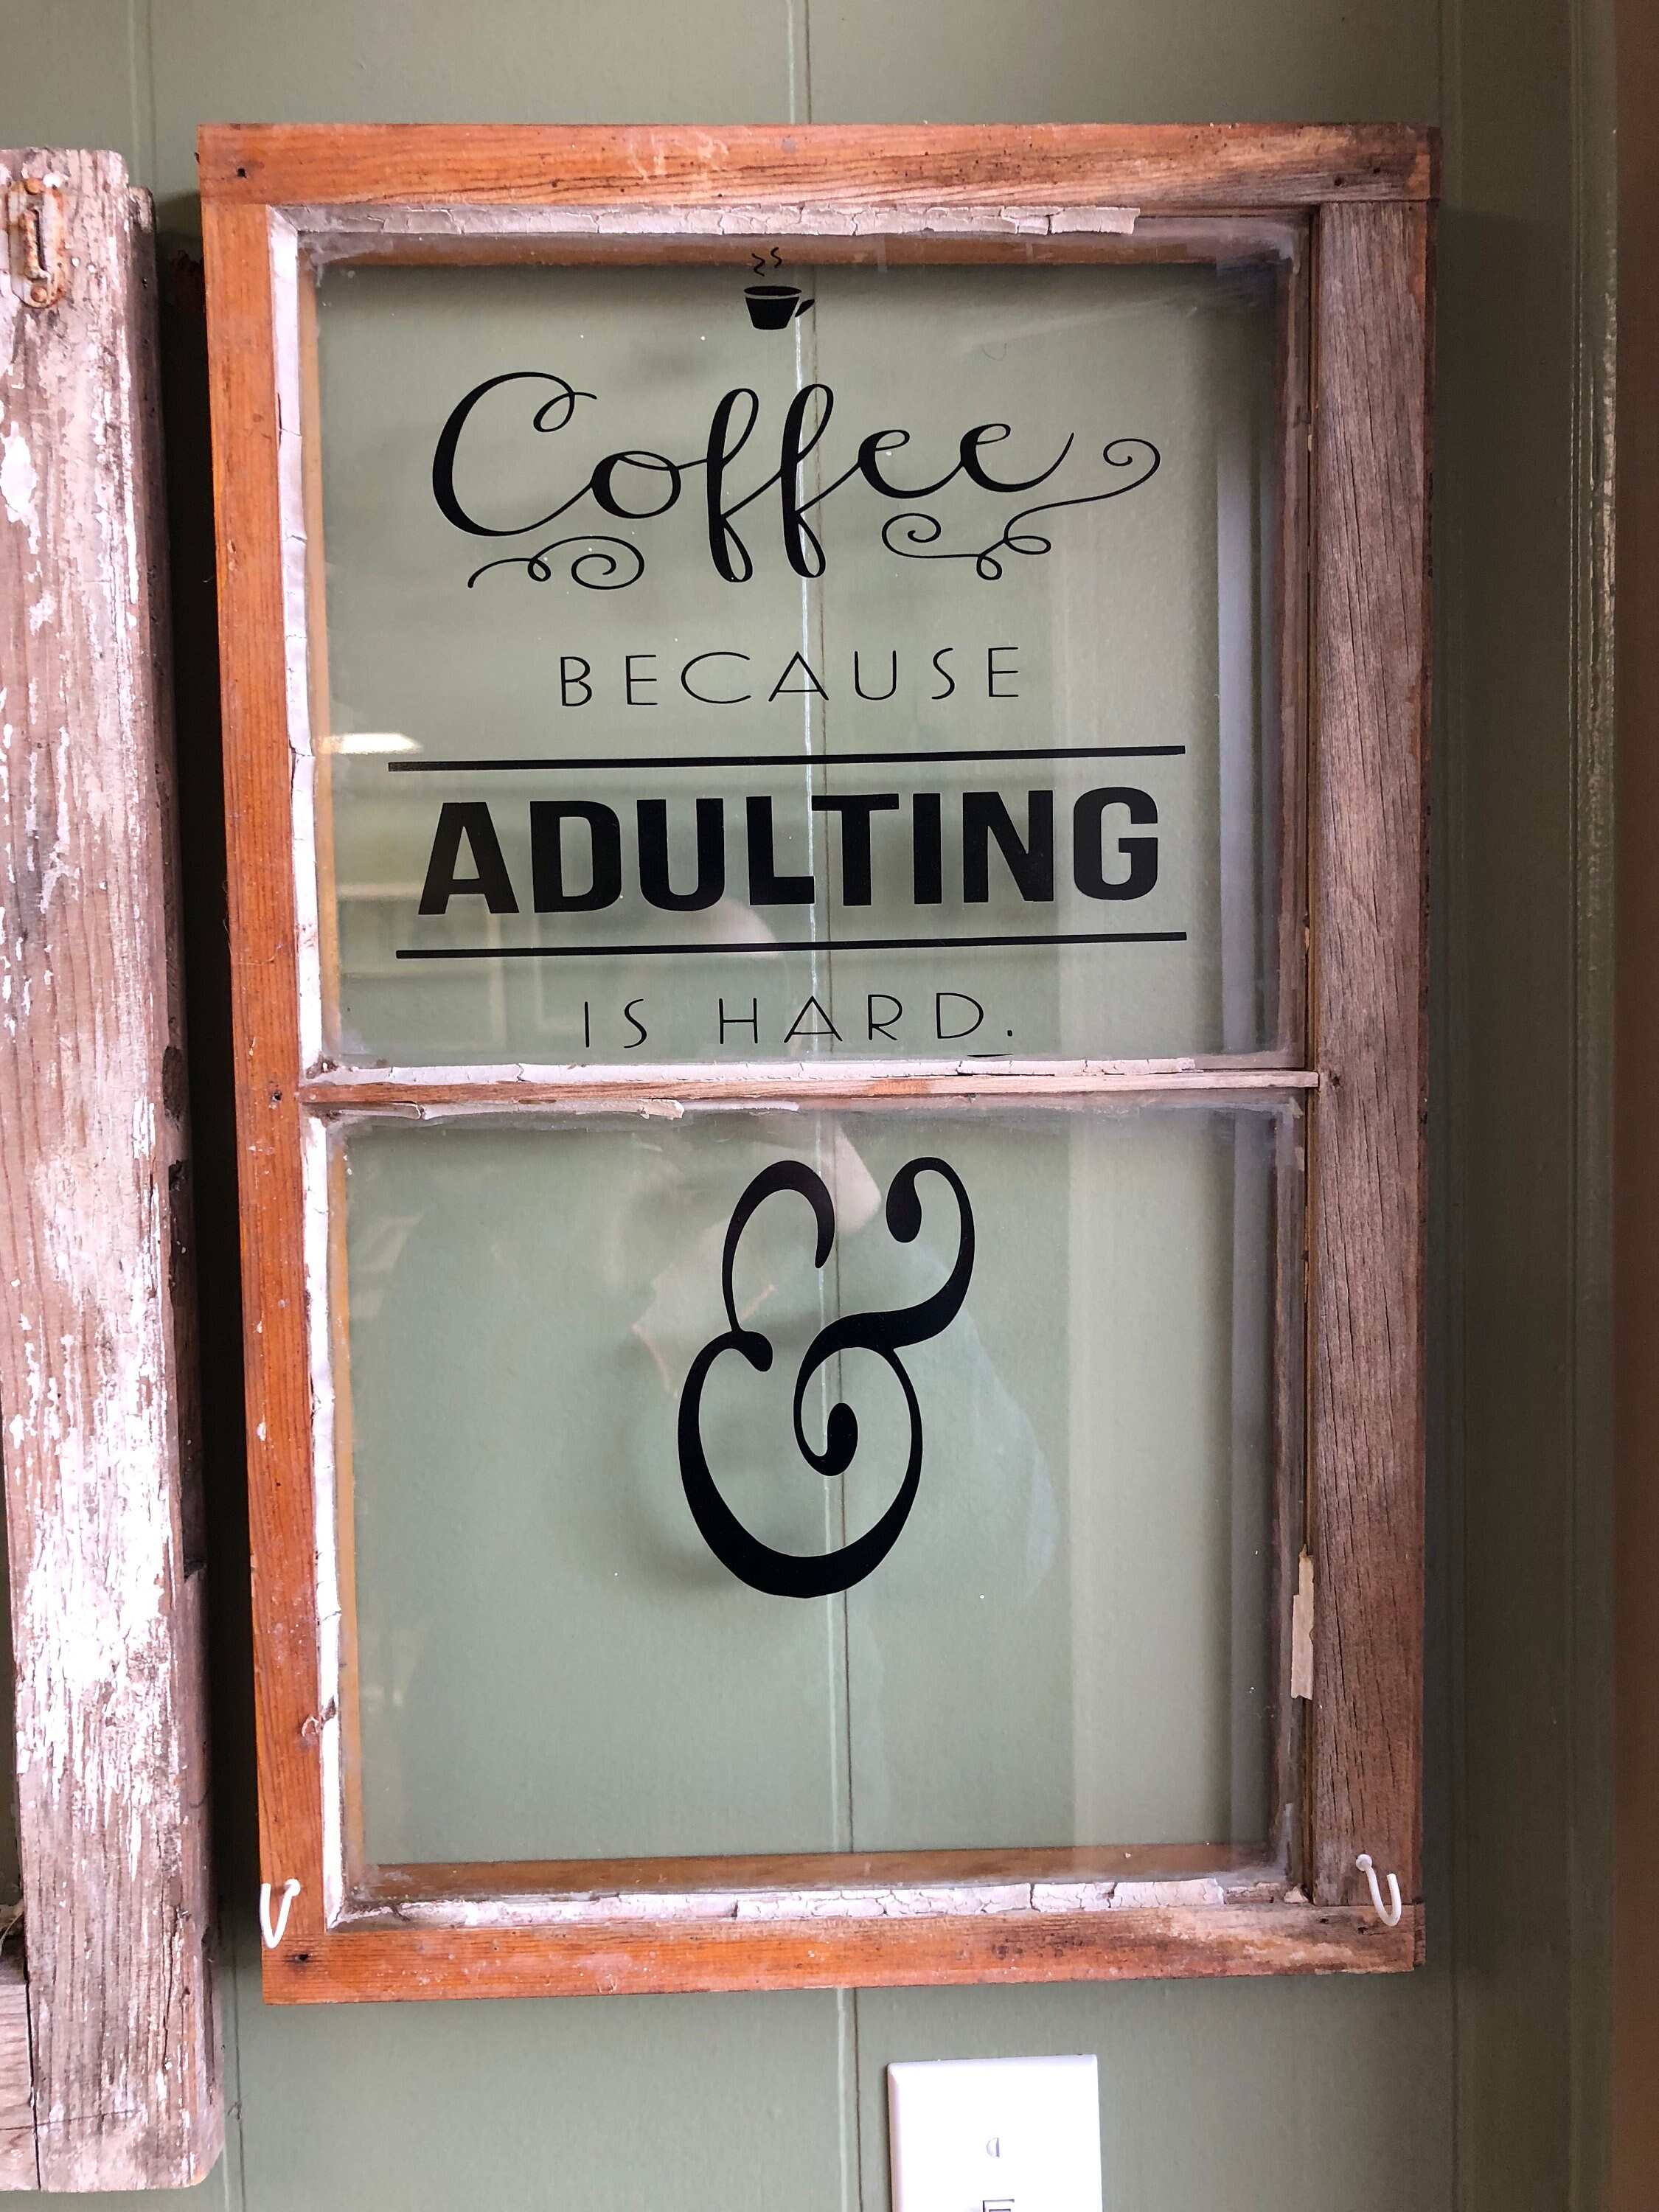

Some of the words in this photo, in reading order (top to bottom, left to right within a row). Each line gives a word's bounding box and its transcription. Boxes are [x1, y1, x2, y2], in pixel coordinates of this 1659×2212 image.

[432, 371, 1074, 583] Coffee
[560, 647, 1019, 707] BECAUSE
[417, 786, 1158, 916] ADULTING
[584, 998, 647, 1048] IS
[718, 992, 1013, 1045] HARD.
[677, 1155, 976, 1599] &
